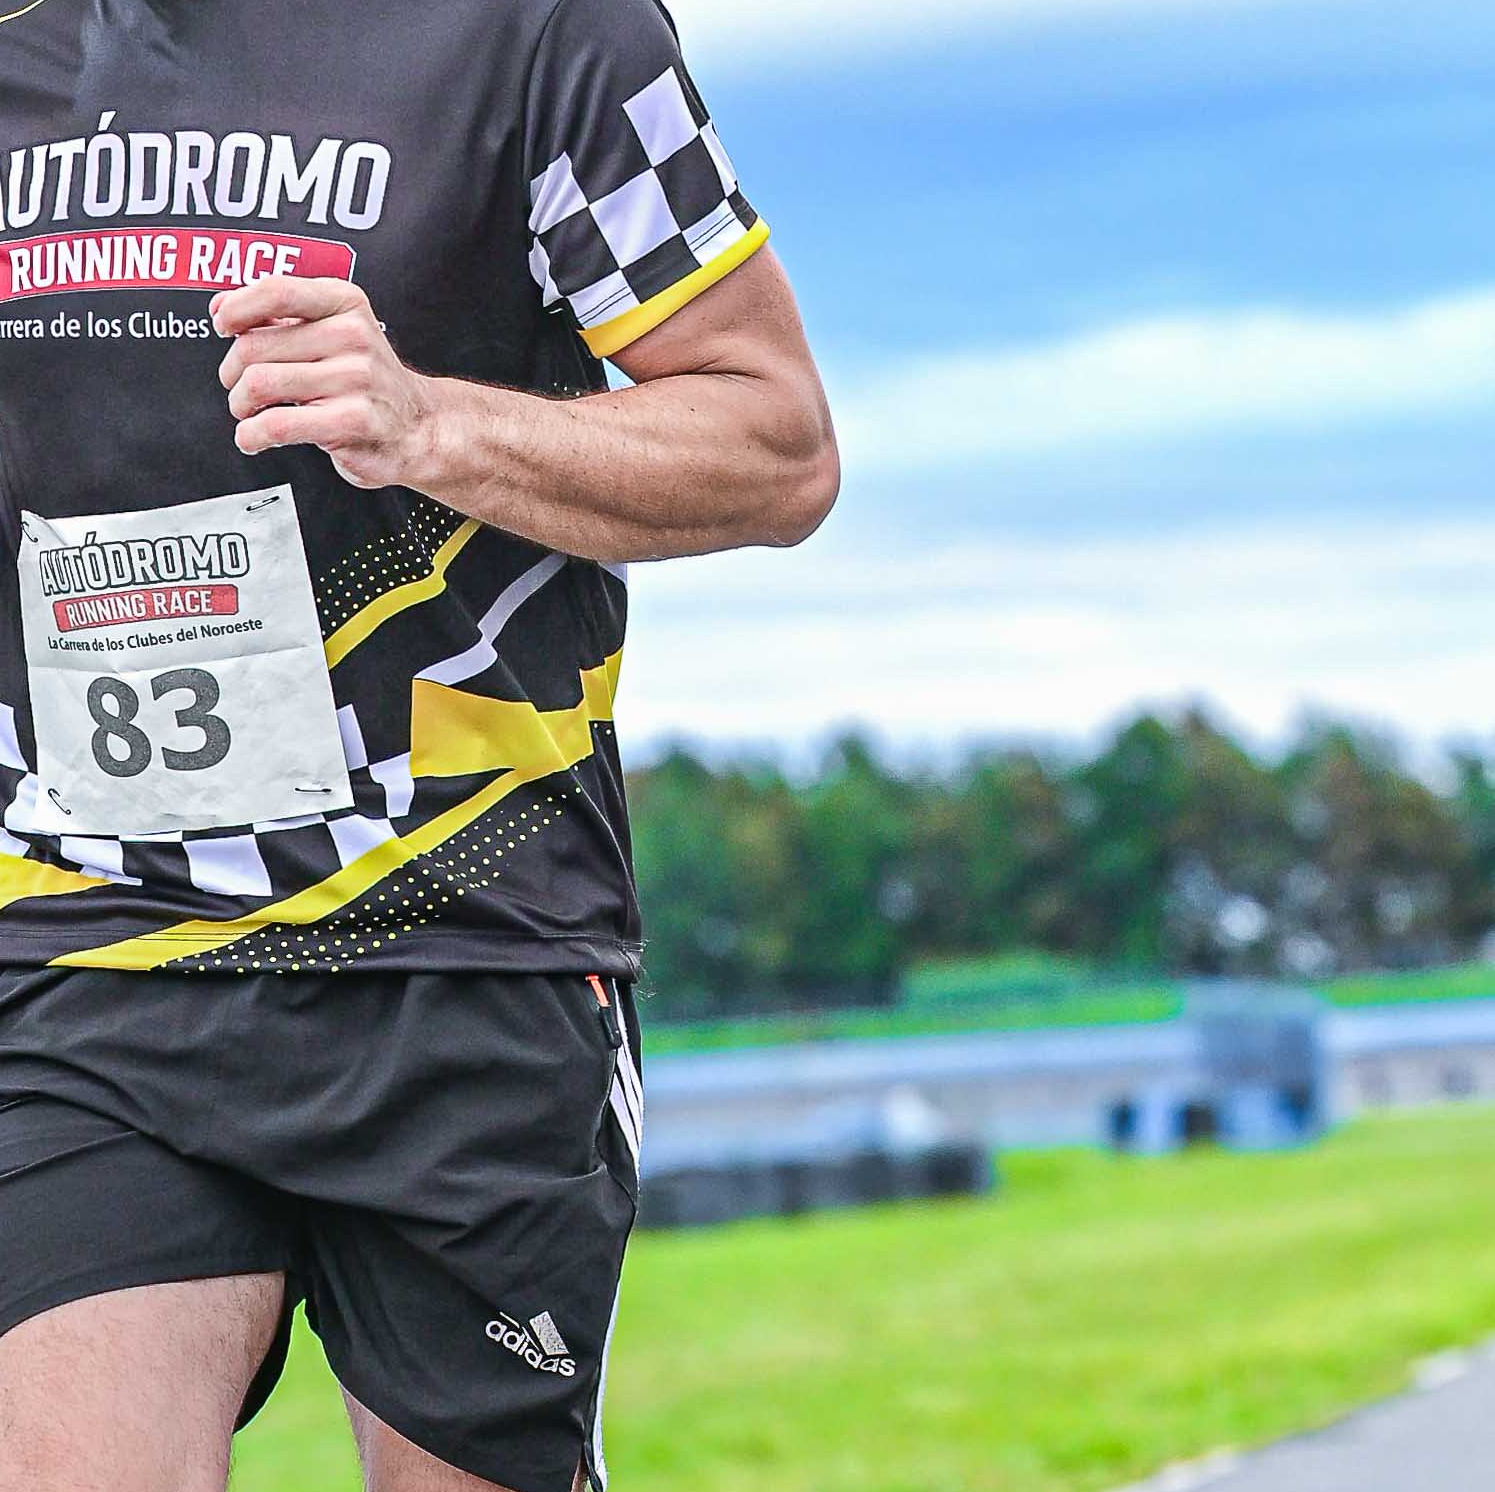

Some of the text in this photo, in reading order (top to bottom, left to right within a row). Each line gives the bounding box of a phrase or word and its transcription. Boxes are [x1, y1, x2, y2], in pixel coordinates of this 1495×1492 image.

[8, 234, 301, 294] RUNNING RACE
[50, 312, 81, 338] de
[88, 311, 123, 338] los
[128, 311, 210, 339] Clubes
[40, 532, 250, 596] AUTÓDROMO
[48, 618, 264, 652] La Carrera de los Clubes del Noroeste
[66, 588, 213, 628] RUNNING RACE
[87, 668, 232, 777] 83
[485, 1319, 577, 1377] adidas
